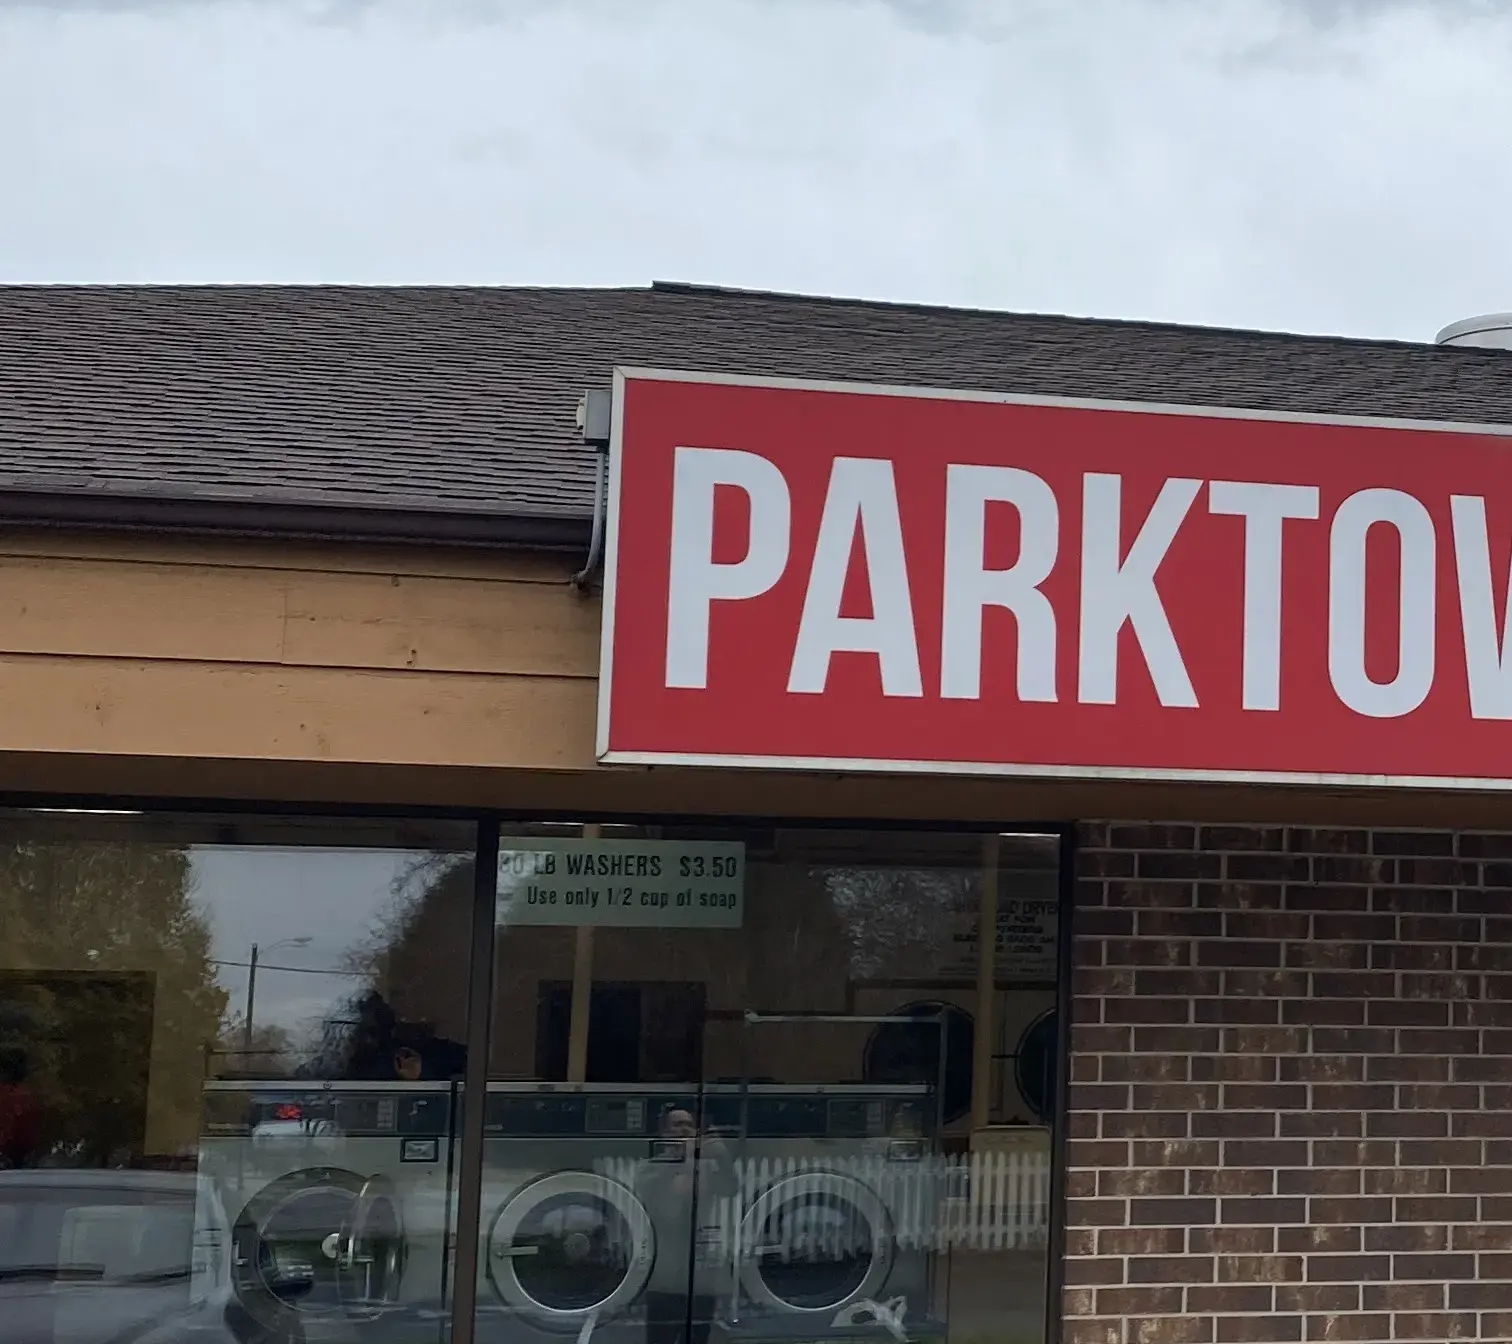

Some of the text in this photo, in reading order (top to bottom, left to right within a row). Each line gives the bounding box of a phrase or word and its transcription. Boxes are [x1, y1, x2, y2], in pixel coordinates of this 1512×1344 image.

[534, 853, 556, 875] LB
[566, 853, 662, 877] WASHERS
[679, 855, 737, 878] $3.50
[527, 885, 737, 909] Use only 1/2 cup of soap
